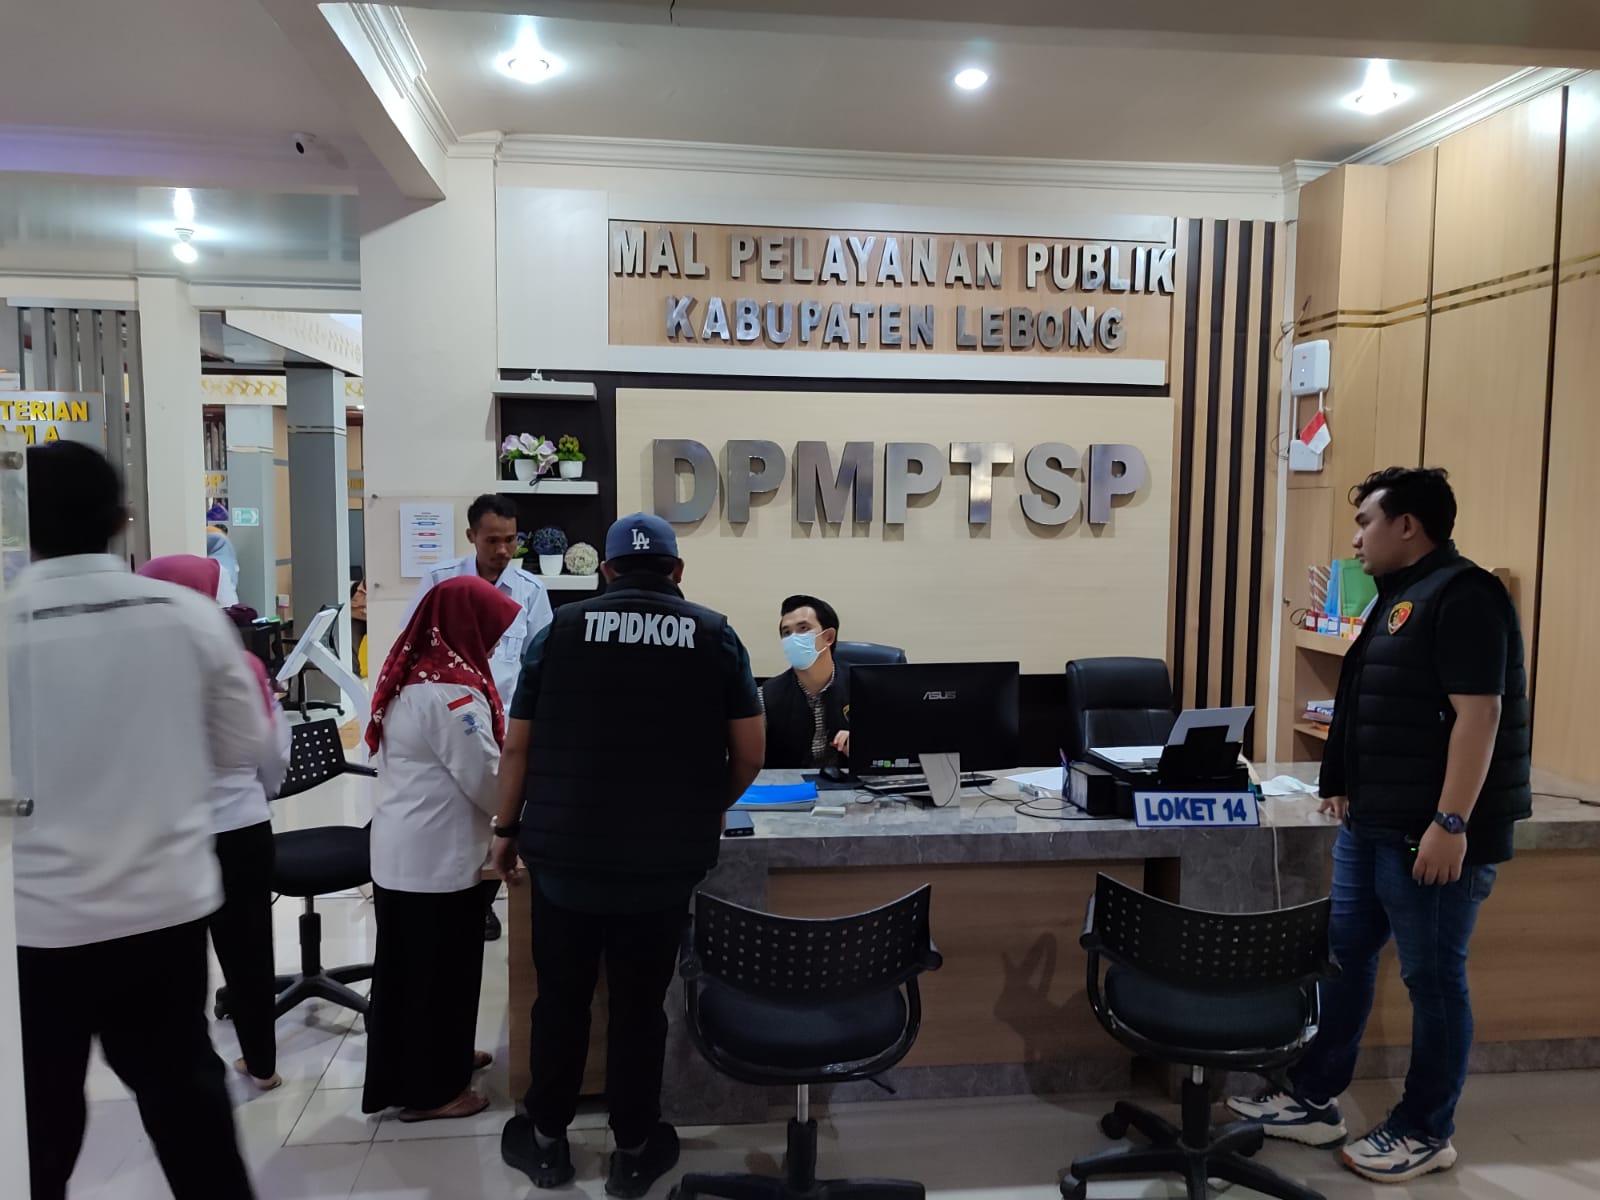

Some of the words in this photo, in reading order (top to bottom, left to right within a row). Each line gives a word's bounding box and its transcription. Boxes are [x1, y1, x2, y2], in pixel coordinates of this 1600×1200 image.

[613, 227, 707, 277] MAL
[730, 232, 1002, 287] PELAYANAN
[1026, 242, 1177, 294] PUBLIK
[666, 295, 934, 346] KABUPATEN
[956, 304, 1125, 350] LEBONG
[0, 400, 88, 421] TERIAN
[652, 439, 1149, 526] DPMPTSP
[631, 528, 650, 550] LA
[584, 611, 696, 648] TIPIDKOR
[923, 691, 957, 700] ASUS
[1144, 797, 1216, 821] LOKET
[1223, 798, 1247, 821] 14
